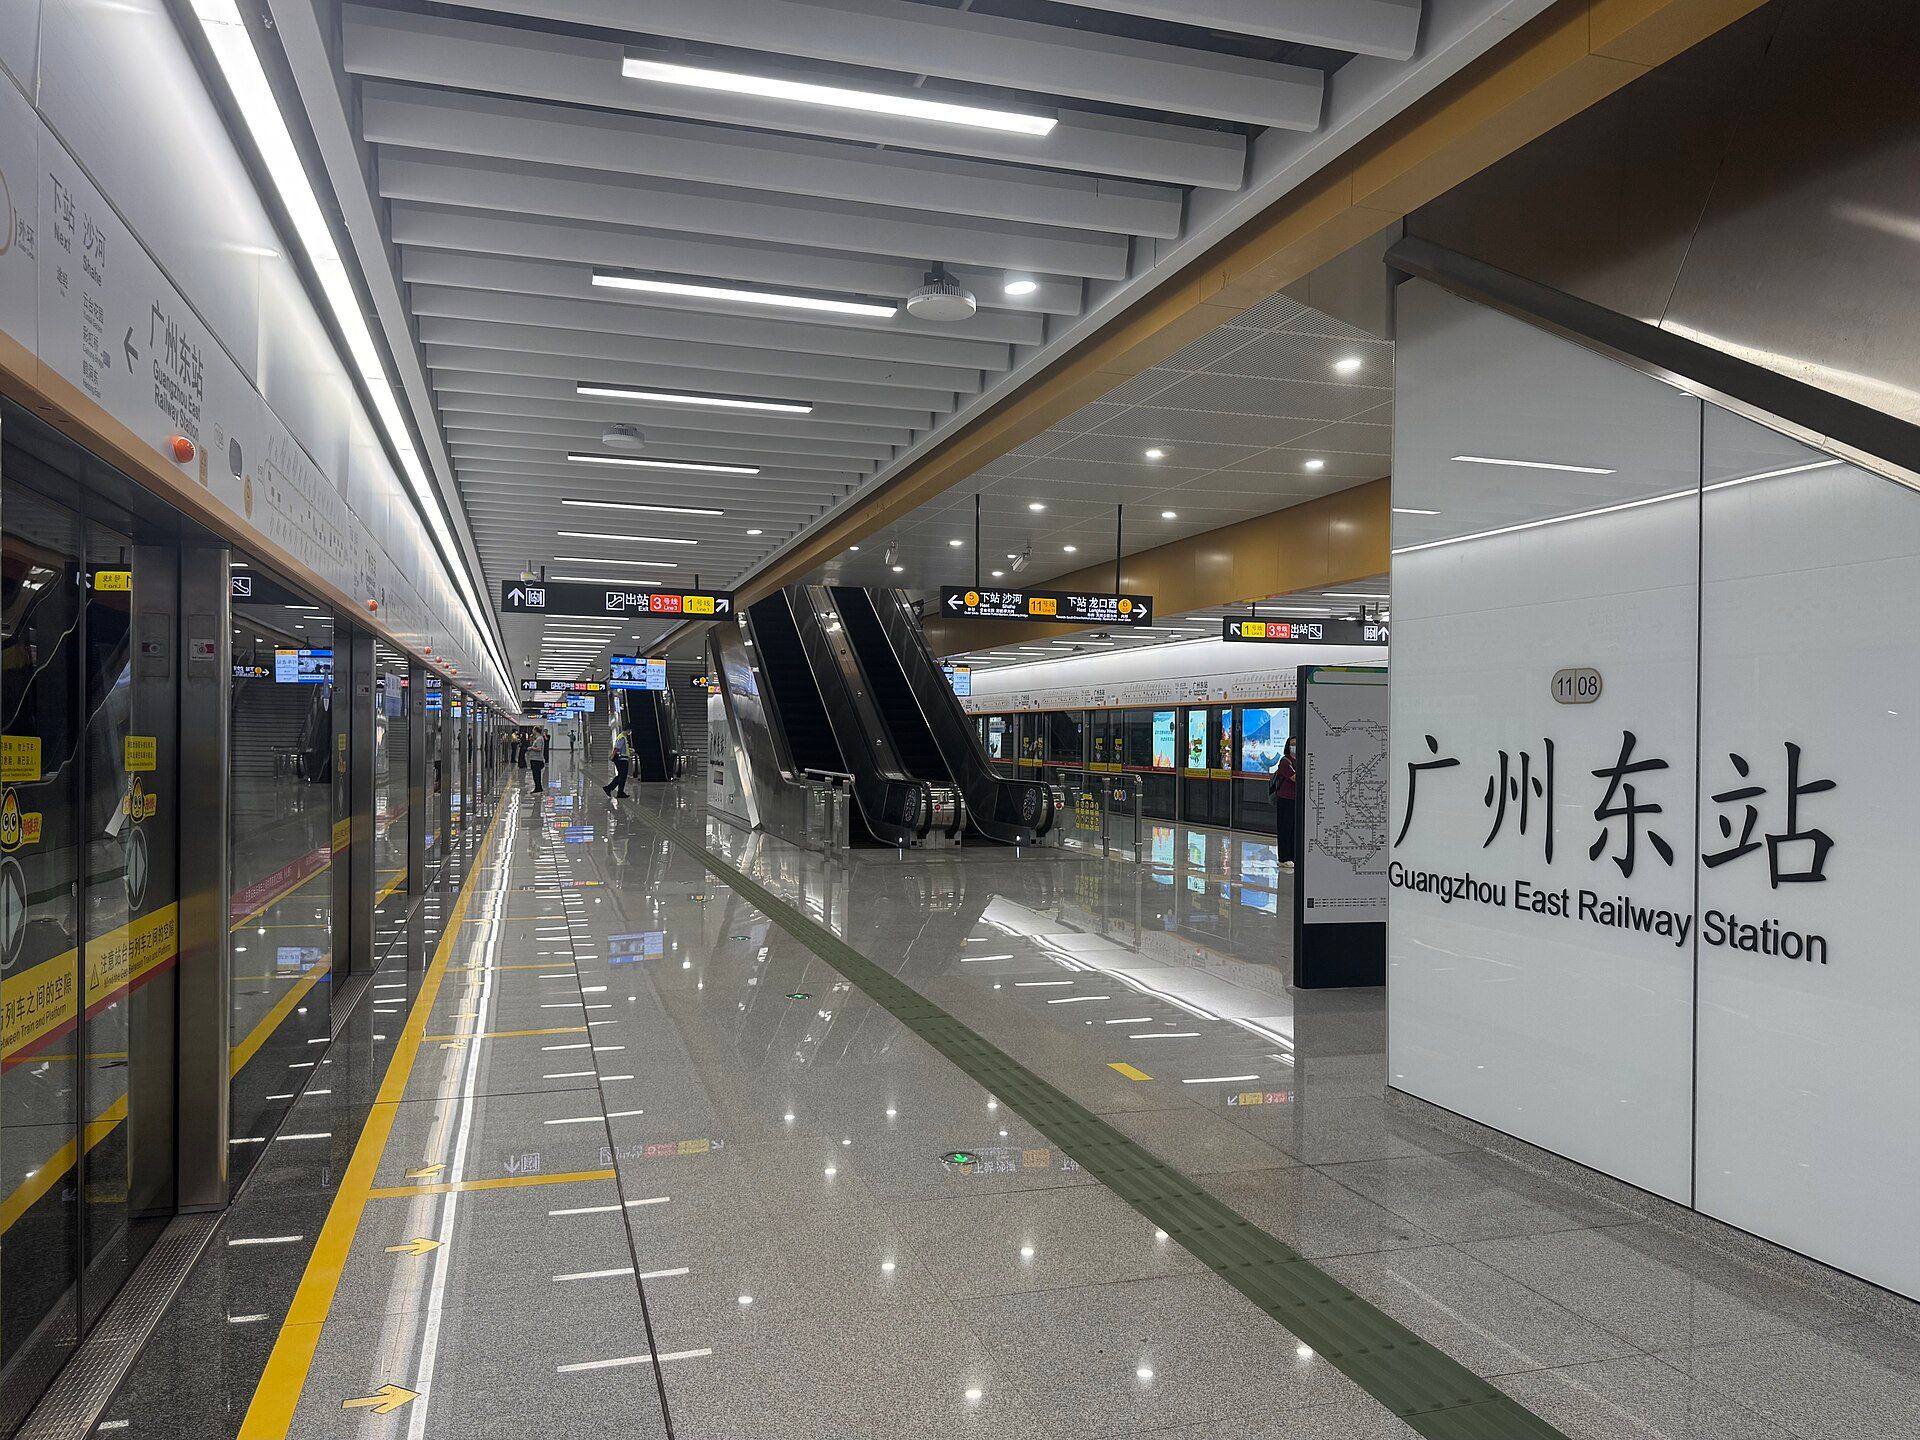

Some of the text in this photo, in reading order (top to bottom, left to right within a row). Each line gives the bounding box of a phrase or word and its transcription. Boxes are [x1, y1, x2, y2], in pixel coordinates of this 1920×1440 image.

[50, 172, 106, 267] 下站 沙河
[54, 222, 102, 287] Next Shahe
[150, 299, 203, 402] 广州东站
[153, 358, 200, 423] Guangzhou East
[154, 383, 179, 427] Railway
[179, 408, 199, 442] Station
[625, 593, 649, 606] 出站
[653, 597, 662, 610] 3
[687, 599, 693, 611] 1
[969, 592, 1023, 605] 5 下站 沙河
[1030, 600, 1041, 611] 11
[1067, 596, 1087, 608] 下站
[1089, 597, 1118, 609] 龙口西
[1244, 625, 1249, 635] 1
[1268, 625, 1276, 636] 3
[1291, 623, 1308, 634] 出站
[1394, 730, 1837, 889] 广州东站
[1388, 861, 1827, 965] Guangzhou East Railway Station
[100, 919, 175, 976] 注意站台与列车之间的空隙
[21, 1020, 35, 1038] Train
[35, 1015, 45, 1030] and
[46, 1003, 68, 1024] Platform
